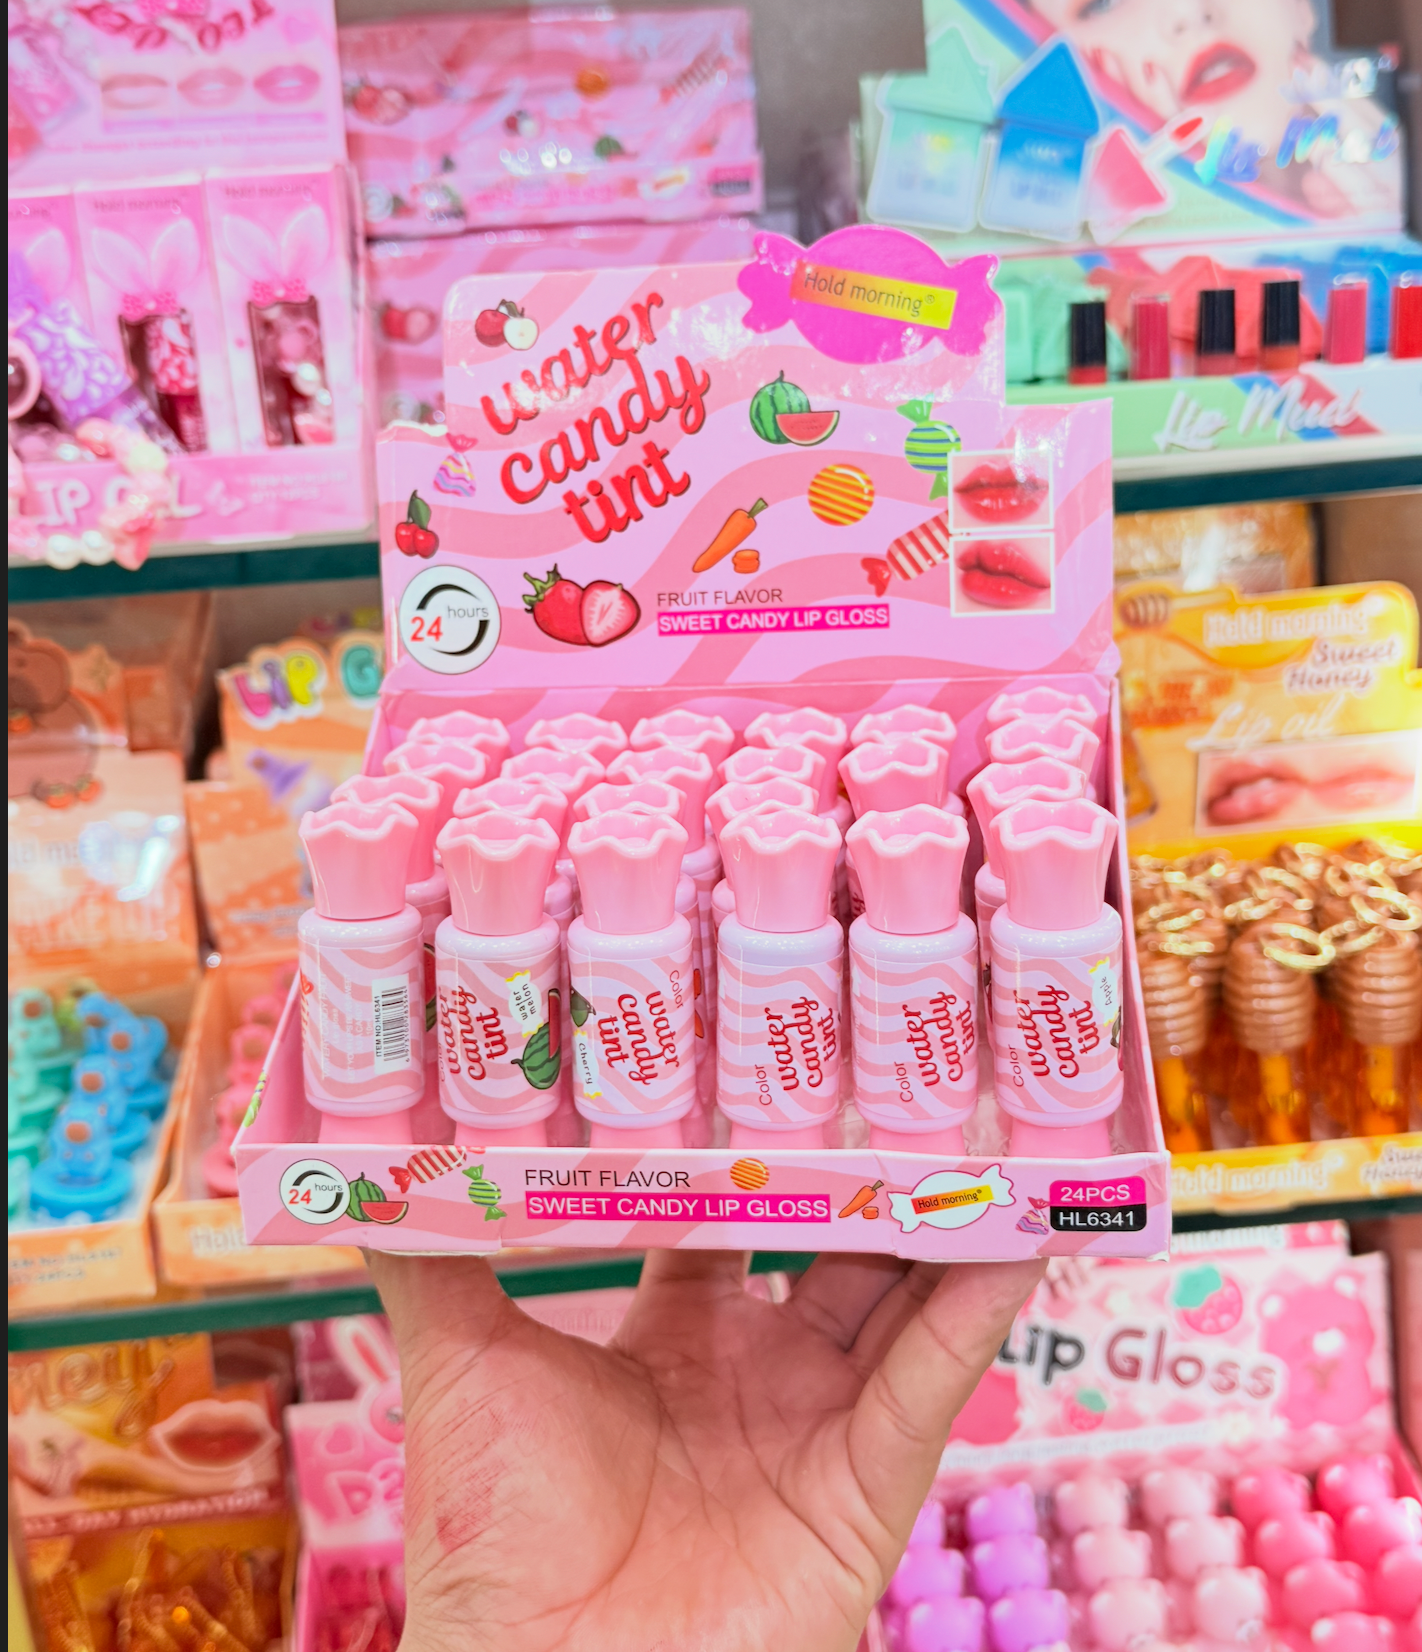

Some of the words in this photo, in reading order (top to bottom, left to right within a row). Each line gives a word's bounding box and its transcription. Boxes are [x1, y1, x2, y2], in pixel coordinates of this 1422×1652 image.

[804, 270, 847, 297] Hold
[480, 292, 664, 435] water
[500, 352, 711, 505] candy
[562, 440, 691, 544] tint
[410, 615, 444, 642] 24
[447, 605, 489, 619] hours
[657, 591, 708, 607] FRUIT
[714, 588, 784, 605] FLAVOR
[659, 614, 722, 633] SWEET
[726, 611, 790, 630] CANDY
[794, 610, 821, 627] LIP
[825, 608, 889, 626] GLOSS
[522, 983, 537, 1015] melon
[669, 970, 684, 1009] Color
[438, 986, 462, 1075] water
[450, 985, 487, 1081] candy
[476, 1006, 509, 1060] tint
[597, 1014, 630, 1069] tint
[617, 993, 664, 1086] candy
[645, 990, 681, 1068] water
[764, 1006, 800, 1092] water
[785, 996, 824, 1088] candy
[817, 1007, 837, 1062] tint
[902, 1004, 941, 1087] water
[923, 991, 964, 1082] candy
[956, 1000, 976, 1055] tint
[1013, 990, 1051, 1077] water
[1031, 984, 1080, 1079] candy
[1068, 1000, 1100, 1055] tint
[579, 1042, 593, 1085] Cherry
[754, 1064, 773, 1106] Color
[894, 1061, 914, 1103] Color
[1008, 1044, 1025, 1088] Color
[288, 1188, 312, 1205] 24
[314, 1183, 343, 1191] hours
[525, 1169, 592, 1186] FRUIT
[599, 1170, 691, 1188] FLAVOR
[918, 1197, 939, 1209] Hold
[1060, 1184, 1131, 1202] 24PCS
[528, 1197, 611, 1215] SWEET
[617, 1198, 698, 1217] CANDY
[705, 1199, 741, 1217] LIP
[746, 1200, 828, 1217] GLOSS
[1059, 1211, 1134, 1227] HL6341
[1106, 1327, 1277, 1400] Gloss
